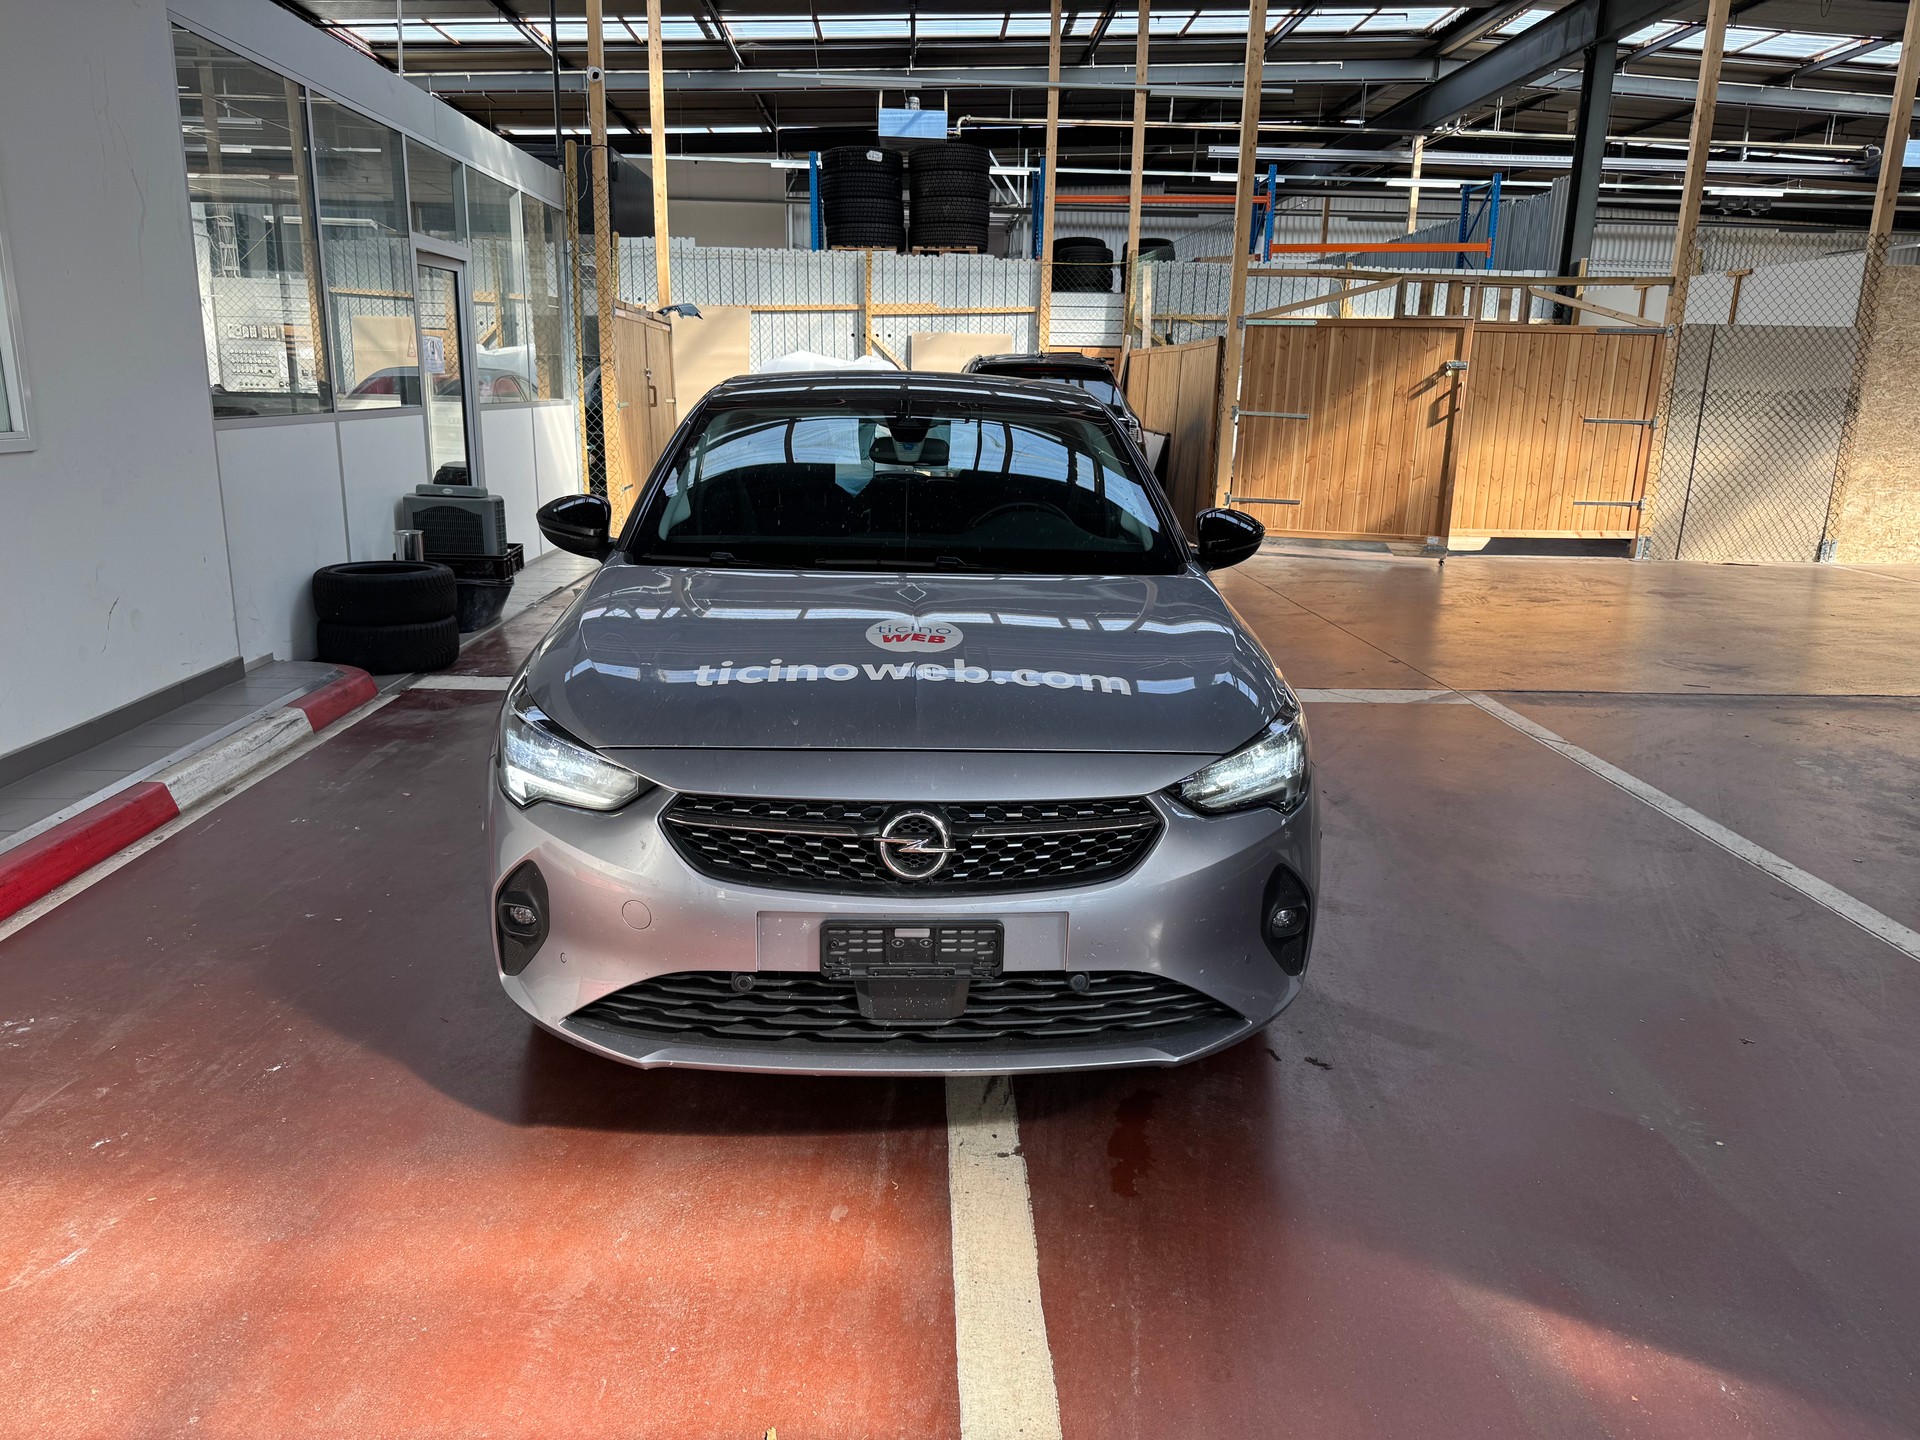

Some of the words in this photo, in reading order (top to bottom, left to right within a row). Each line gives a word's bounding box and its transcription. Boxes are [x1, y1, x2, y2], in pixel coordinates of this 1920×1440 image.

[876, 624, 952, 634] ticino
[882, 633, 946, 643] WEB
[693, 658, 1132, 695] ticinoweb.com
